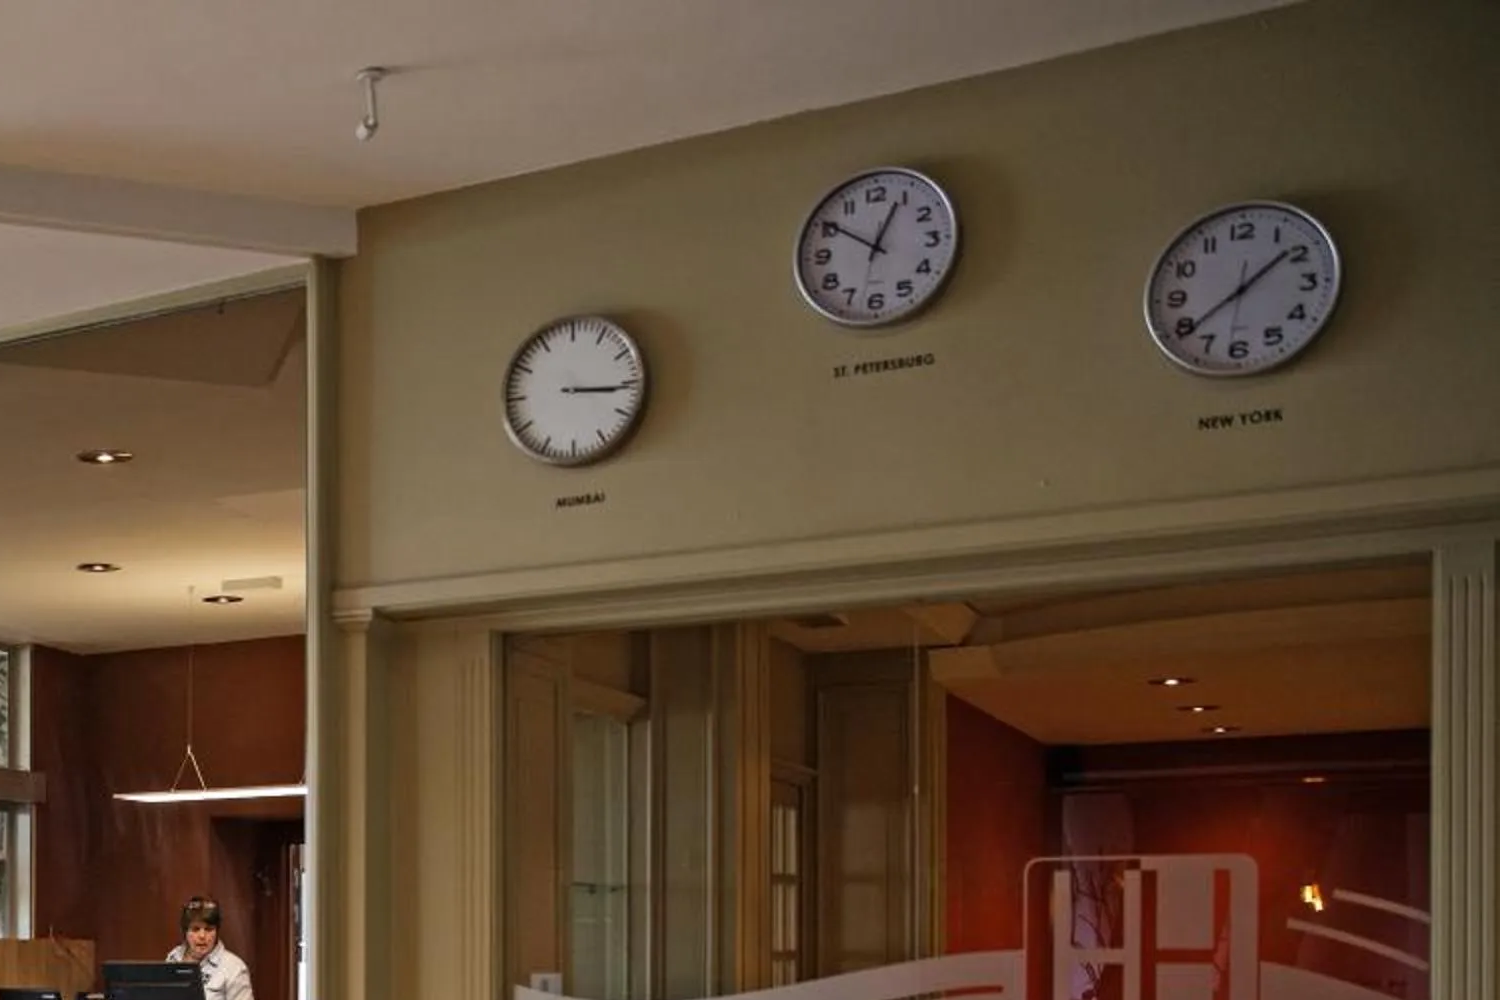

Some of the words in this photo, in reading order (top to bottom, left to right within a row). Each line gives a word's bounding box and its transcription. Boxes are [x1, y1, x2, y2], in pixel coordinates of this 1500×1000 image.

[866, 186, 887, 203] 12
[902, 190, 908, 205] 1
[844, 199, 855, 215] 11
[916, 206, 932, 223] 2
[925, 230, 941, 247] 3
[1230, 222, 1256, 241] 12
[1274, 226, 1281, 243] 1
[1203, 236, 1217, 254] 11
[814, 249, 832, 265] 9
[1290, 245, 1309, 263] 2
[916, 258, 932, 275] 4
[1176, 260, 1196, 278] 10
[822, 273, 840, 290] 8
[896, 280, 913, 297] 5
[1299, 273, 1318, 291] 3
[842, 288, 857, 305] 7
[867, 293, 884, 310] 6
[1167, 290, 1188, 308] 9
[1287, 303, 1306, 320] 4
[1175, 317, 1195, 337] 8
[1200, 334, 1216, 353] 7
[1263, 326, 1284, 346] 5
[1228, 341, 1249, 359] 6
[853, 353, 936, 375] PETERSBURG
[1198, 415, 1234, 430] NEW
[1239, 408, 1284, 426] YORK
[555, 493, 606, 509] MUMBAI
